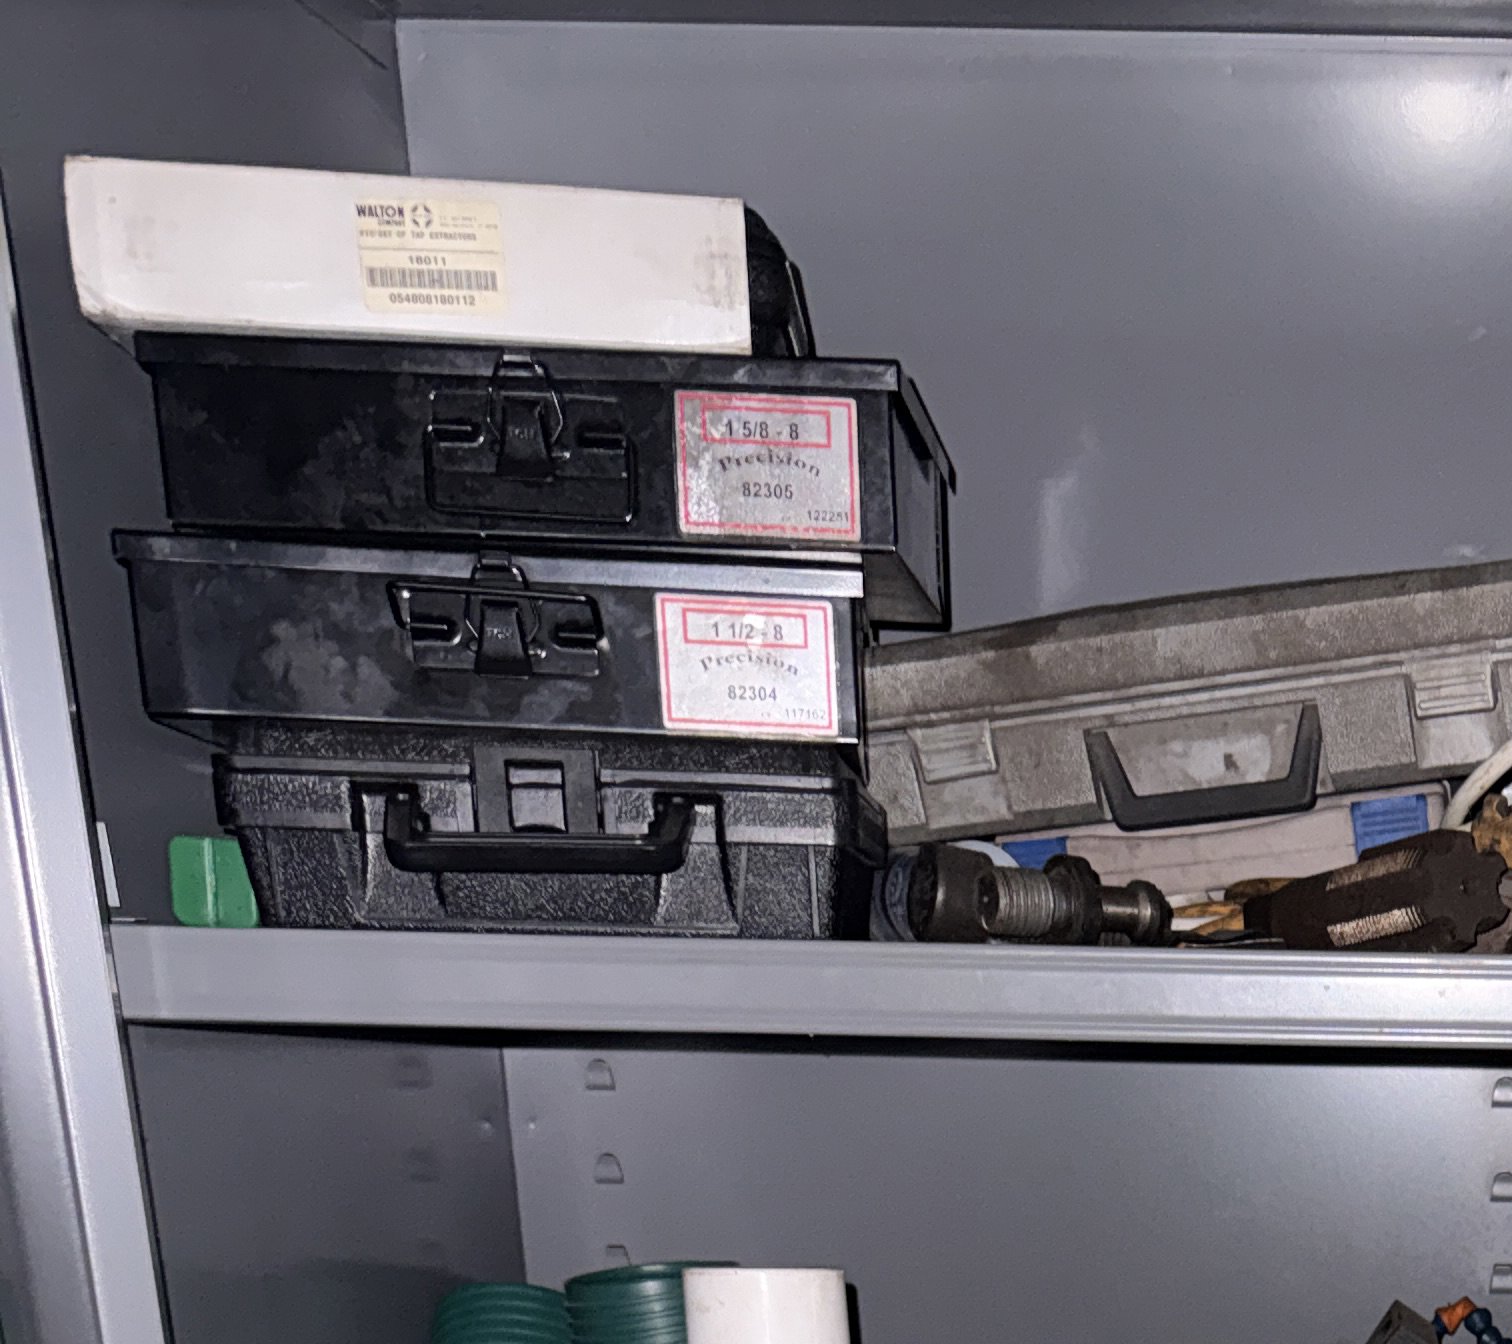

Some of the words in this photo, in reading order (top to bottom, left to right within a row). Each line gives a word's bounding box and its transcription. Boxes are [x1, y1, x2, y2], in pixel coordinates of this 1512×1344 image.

[355, 203, 404, 218] WALTON
[725, 419, 733, 437] 1
[742, 421, 769, 439] 5/8
[789, 422, 800, 441] 8
[718, 447, 821, 478] Precision
[742, 482, 794, 500] 82305
[712, 621, 720, 638] 1
[730, 622, 755, 640] 1/2
[773, 624, 784, 642] 8
[699, 650, 800, 677] Precision
[727, 684, 778, 702] 82304
